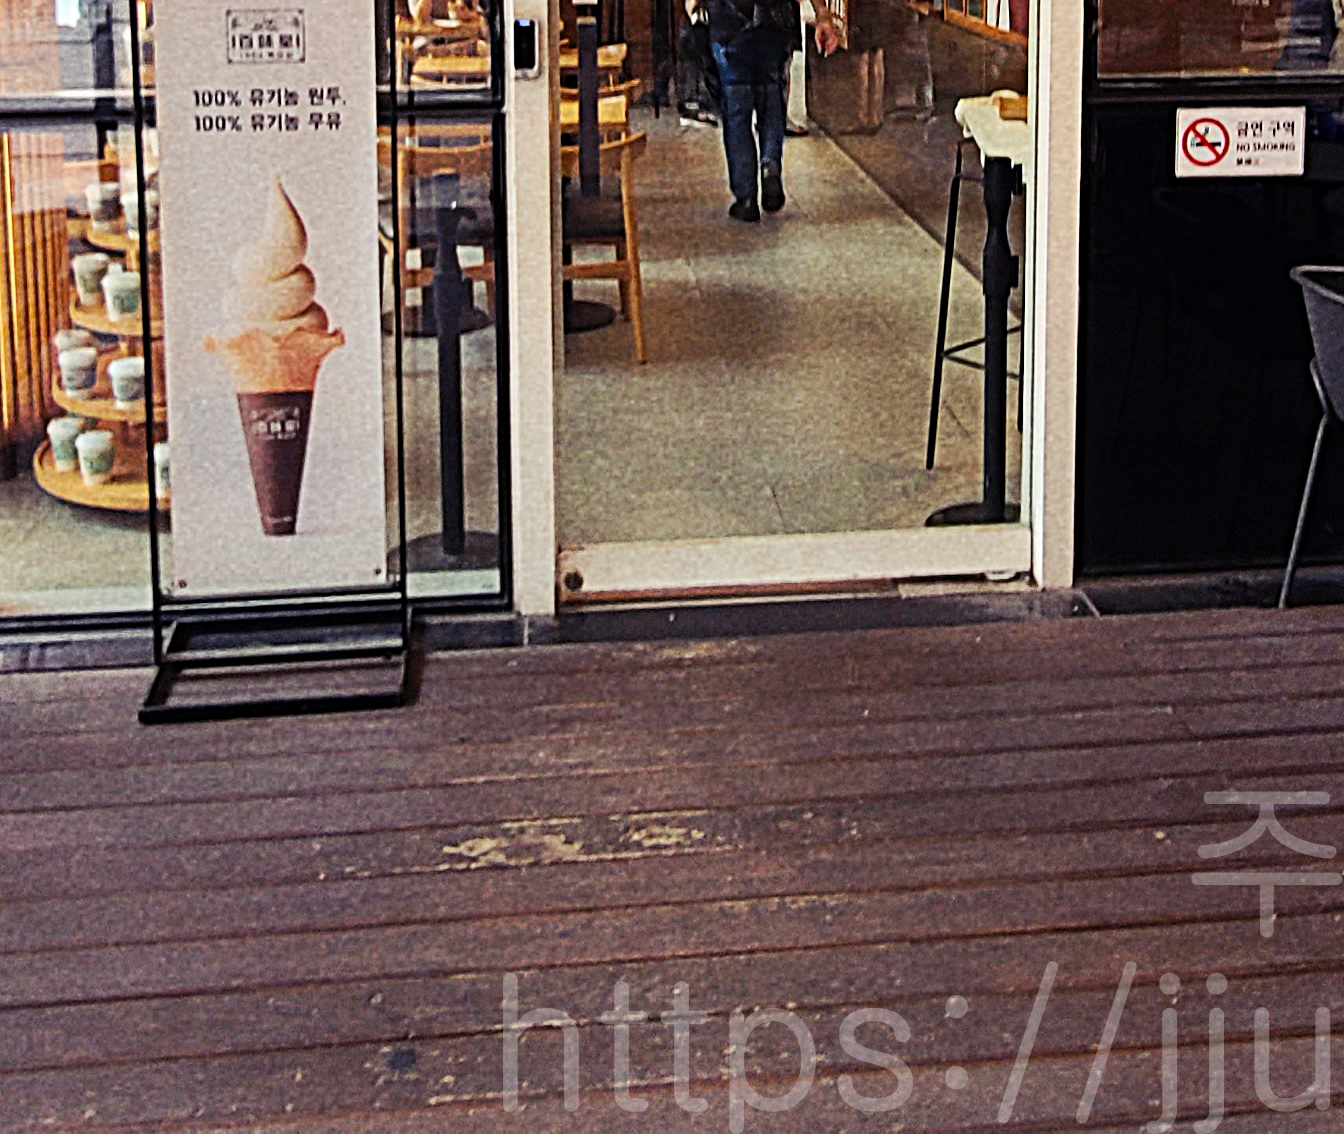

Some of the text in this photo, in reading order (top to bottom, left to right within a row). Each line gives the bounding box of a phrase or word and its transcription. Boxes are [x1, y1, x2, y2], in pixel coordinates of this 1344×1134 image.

[194, 89, 242, 107] 100%
[250, 87, 299, 107] 유기농
[195, 112, 341, 132] 100% 유기농 우유
[1238, 121, 1295, 137] 금연 구역
[1237, 143, 1296, 152] NO SMOKING
